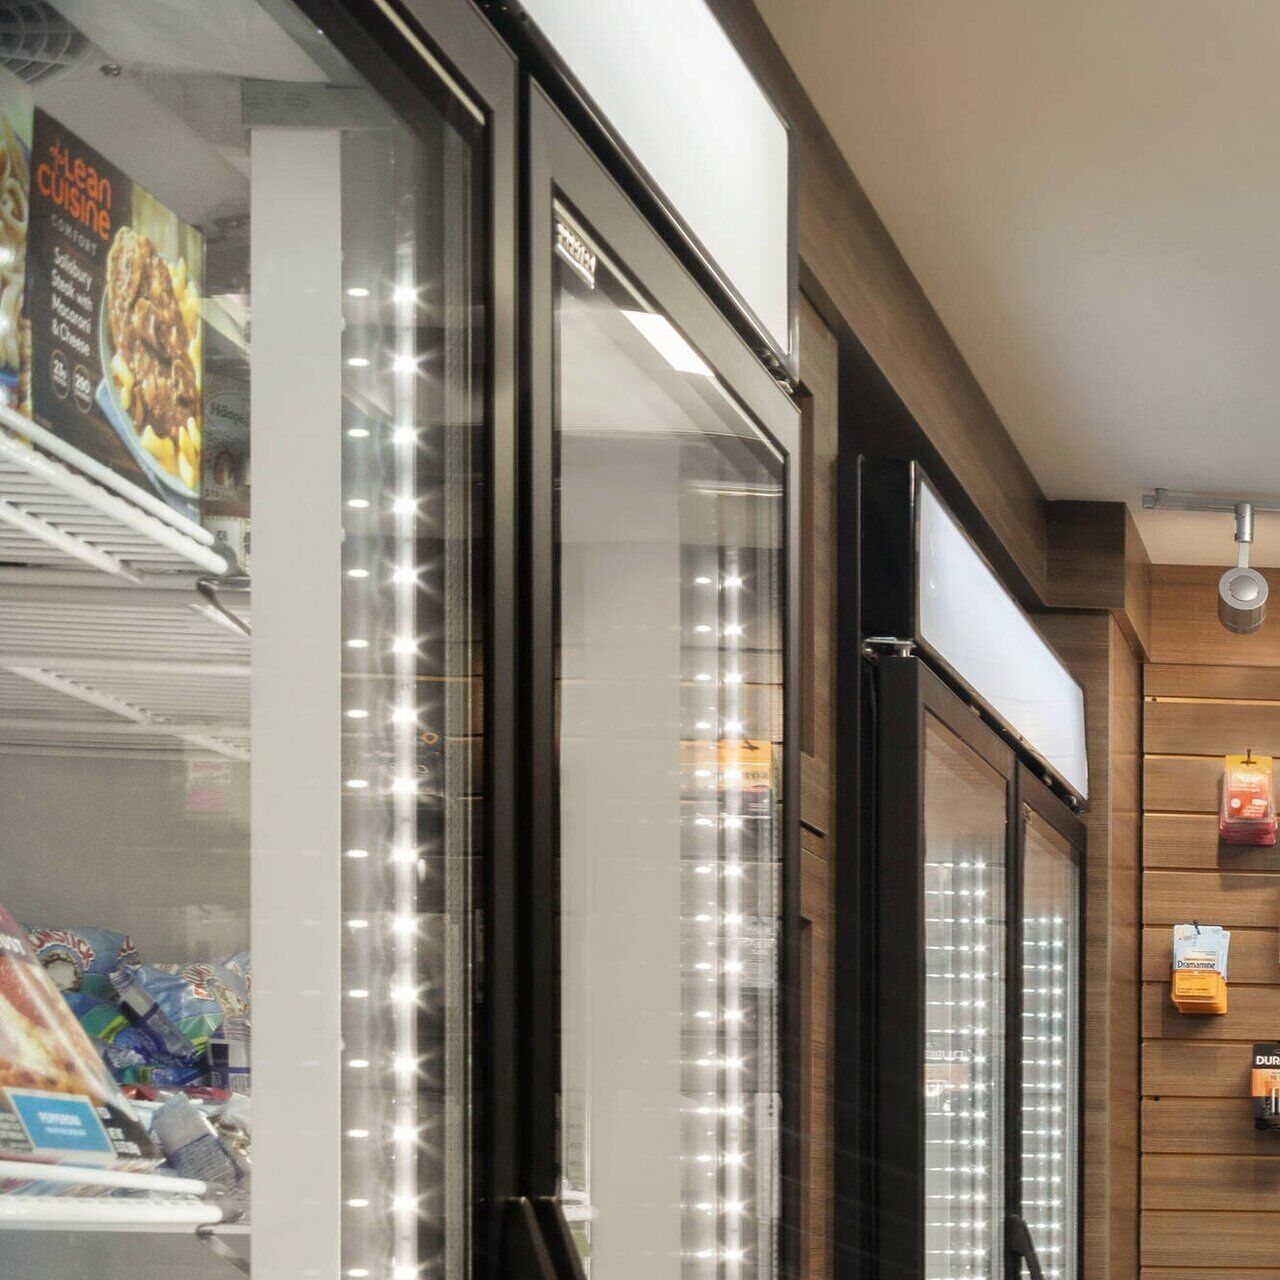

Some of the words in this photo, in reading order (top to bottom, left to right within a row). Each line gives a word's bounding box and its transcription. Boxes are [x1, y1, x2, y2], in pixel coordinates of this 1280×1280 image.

[65, 149, 112, 208] Lean
[51, 269, 75, 299] Steak
[54, 246, 93, 292] Salisbury
[51, 293, 92, 334] Macaroni
[1177, 960, 1216, 969] Dramamine
